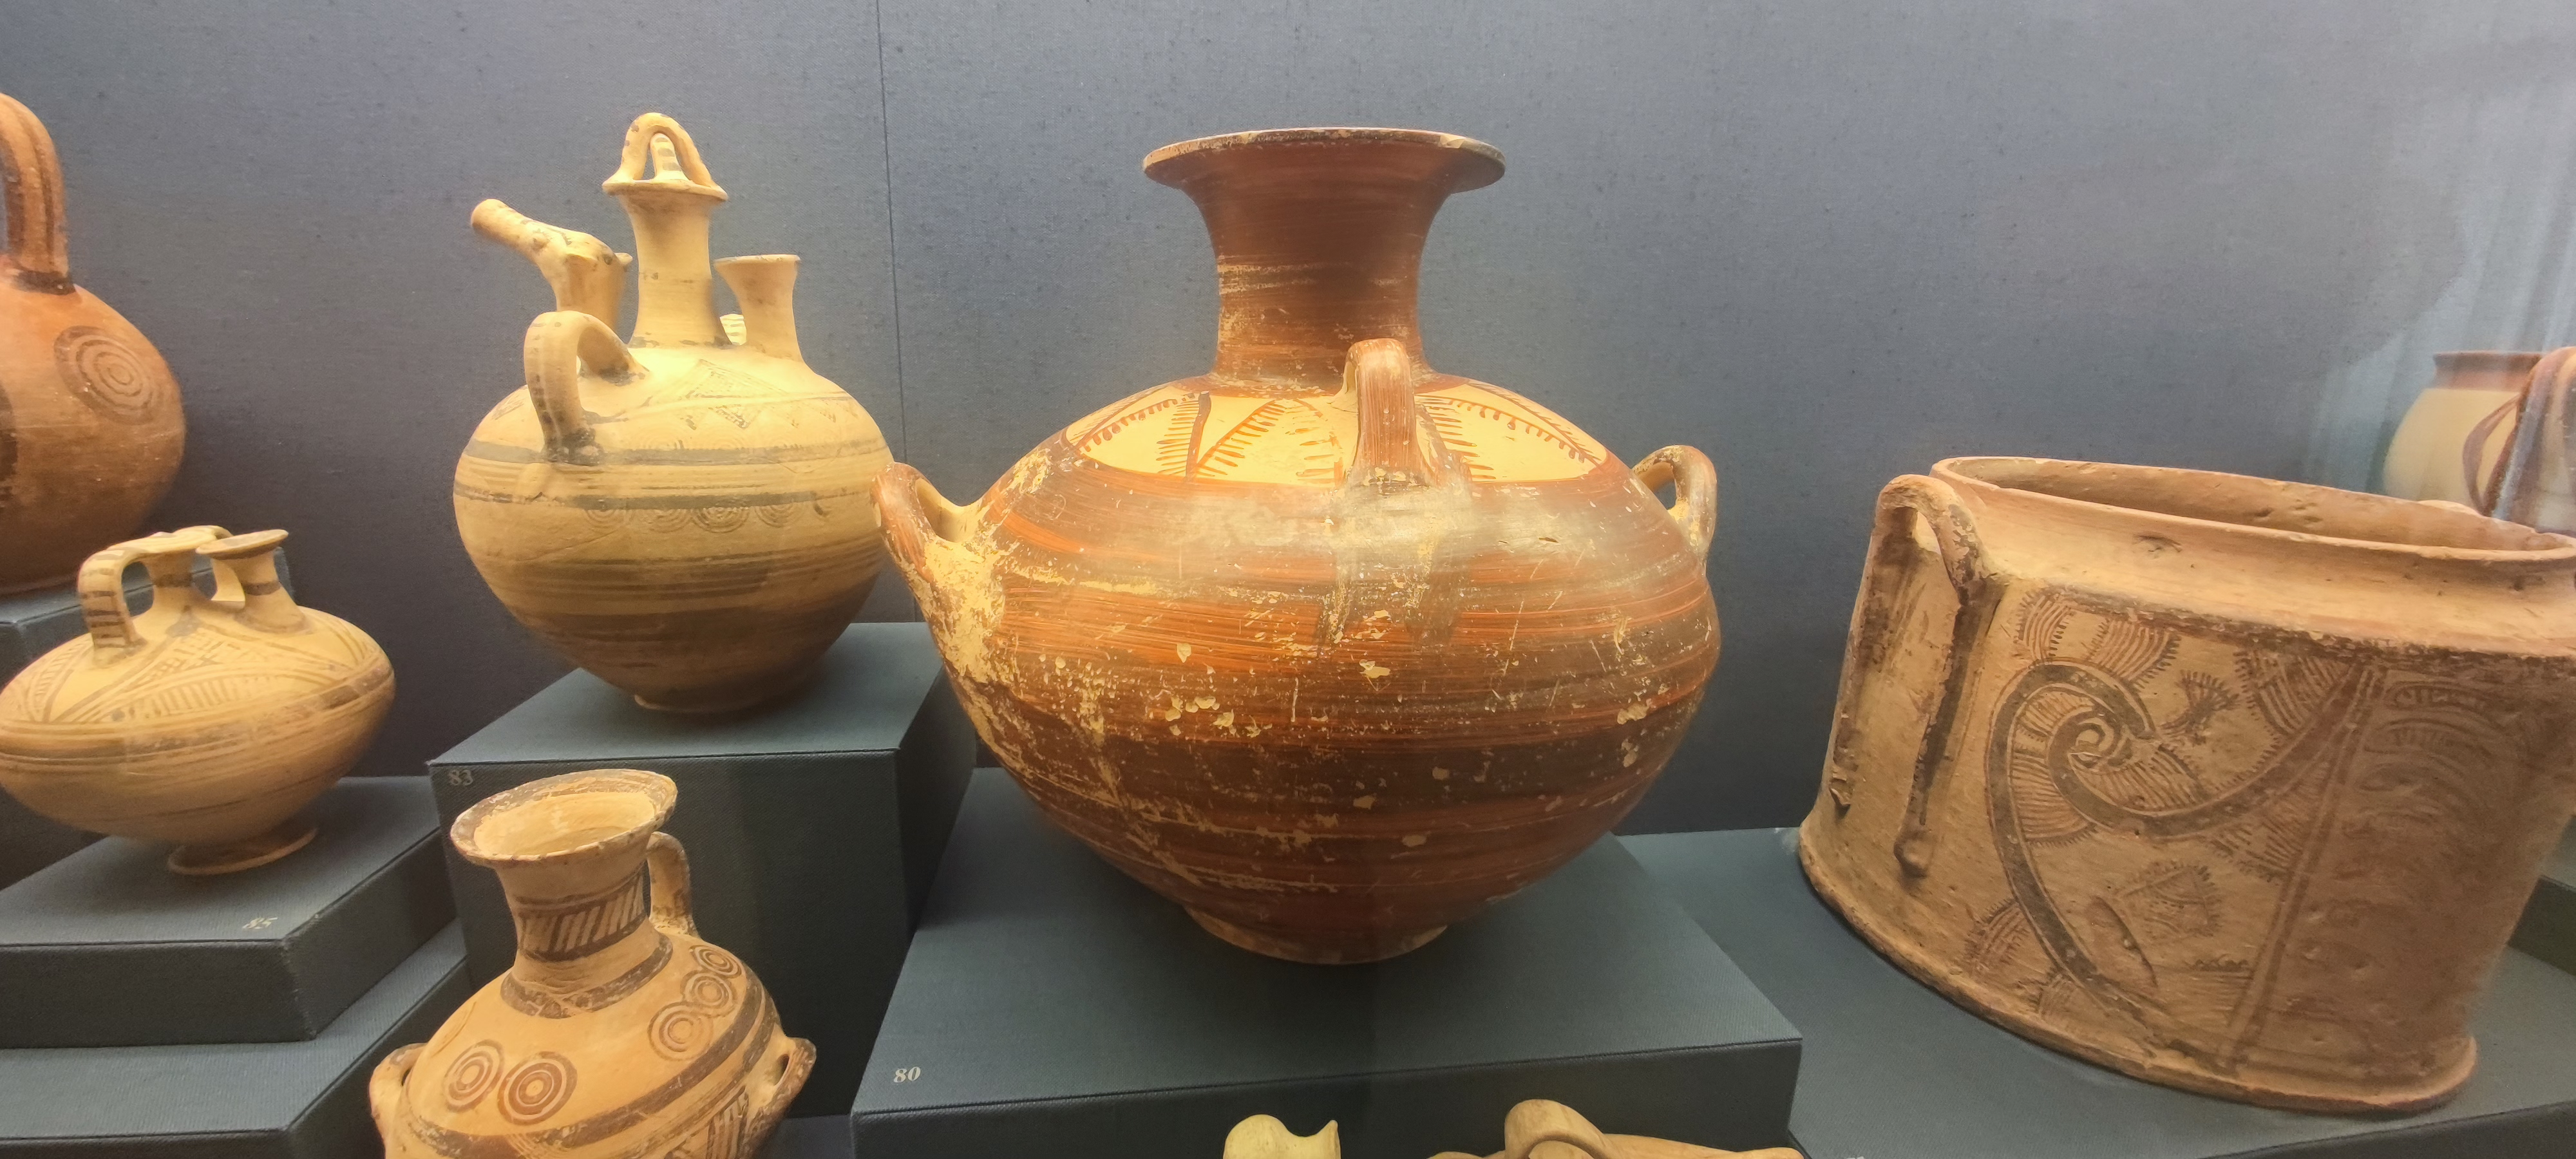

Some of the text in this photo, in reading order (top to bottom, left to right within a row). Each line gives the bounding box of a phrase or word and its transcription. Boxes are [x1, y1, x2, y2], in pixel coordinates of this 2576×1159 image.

[448, 769, 473, 786] 83
[242, 917, 278, 930] 85
[893, 1066, 922, 1083] 80
